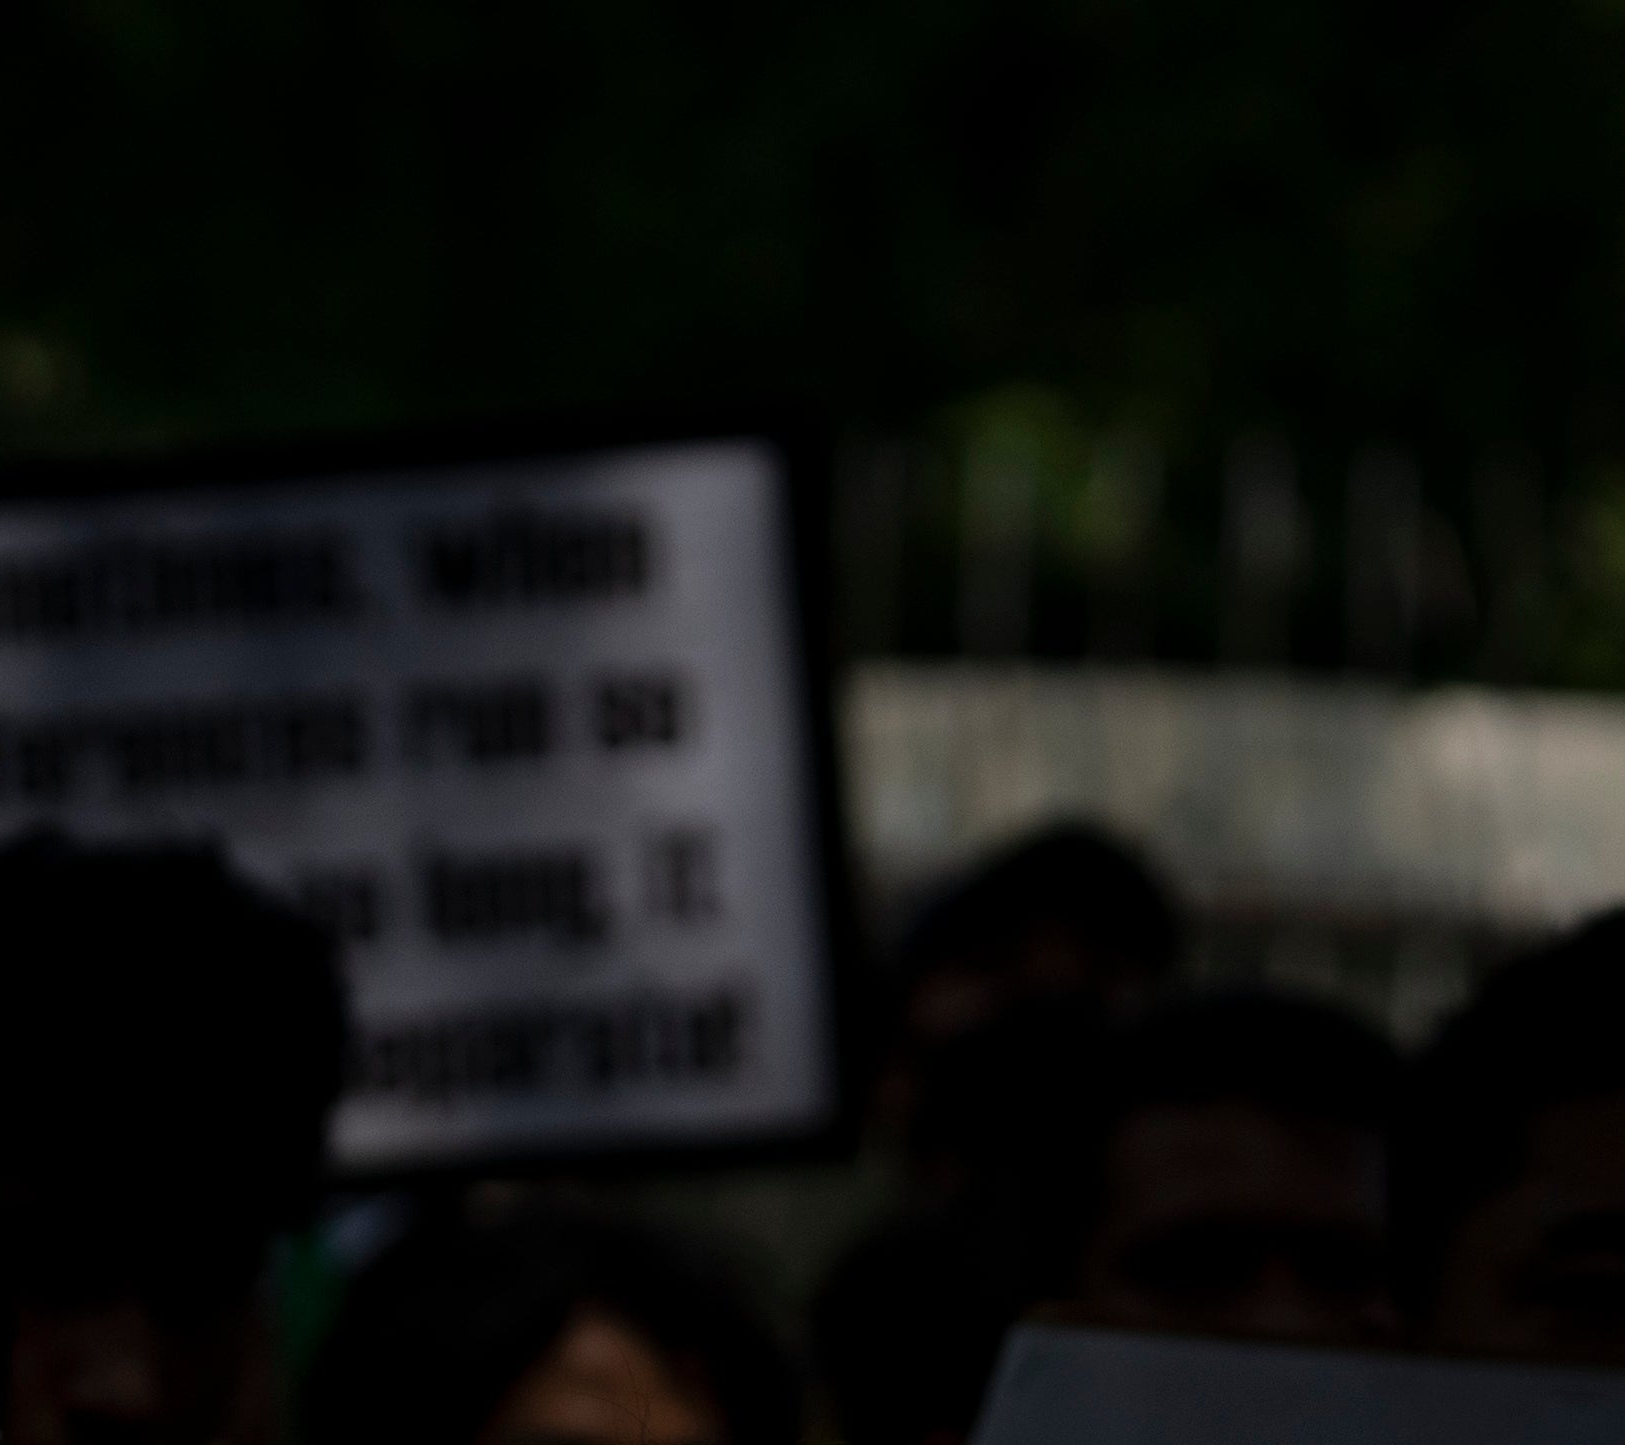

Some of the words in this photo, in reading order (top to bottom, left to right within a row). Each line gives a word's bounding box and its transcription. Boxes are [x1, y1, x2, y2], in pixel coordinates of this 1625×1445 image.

[423, 504, 651, 609] when
[404, 679, 547, 762] run
[595, 679, 679, 746] so
